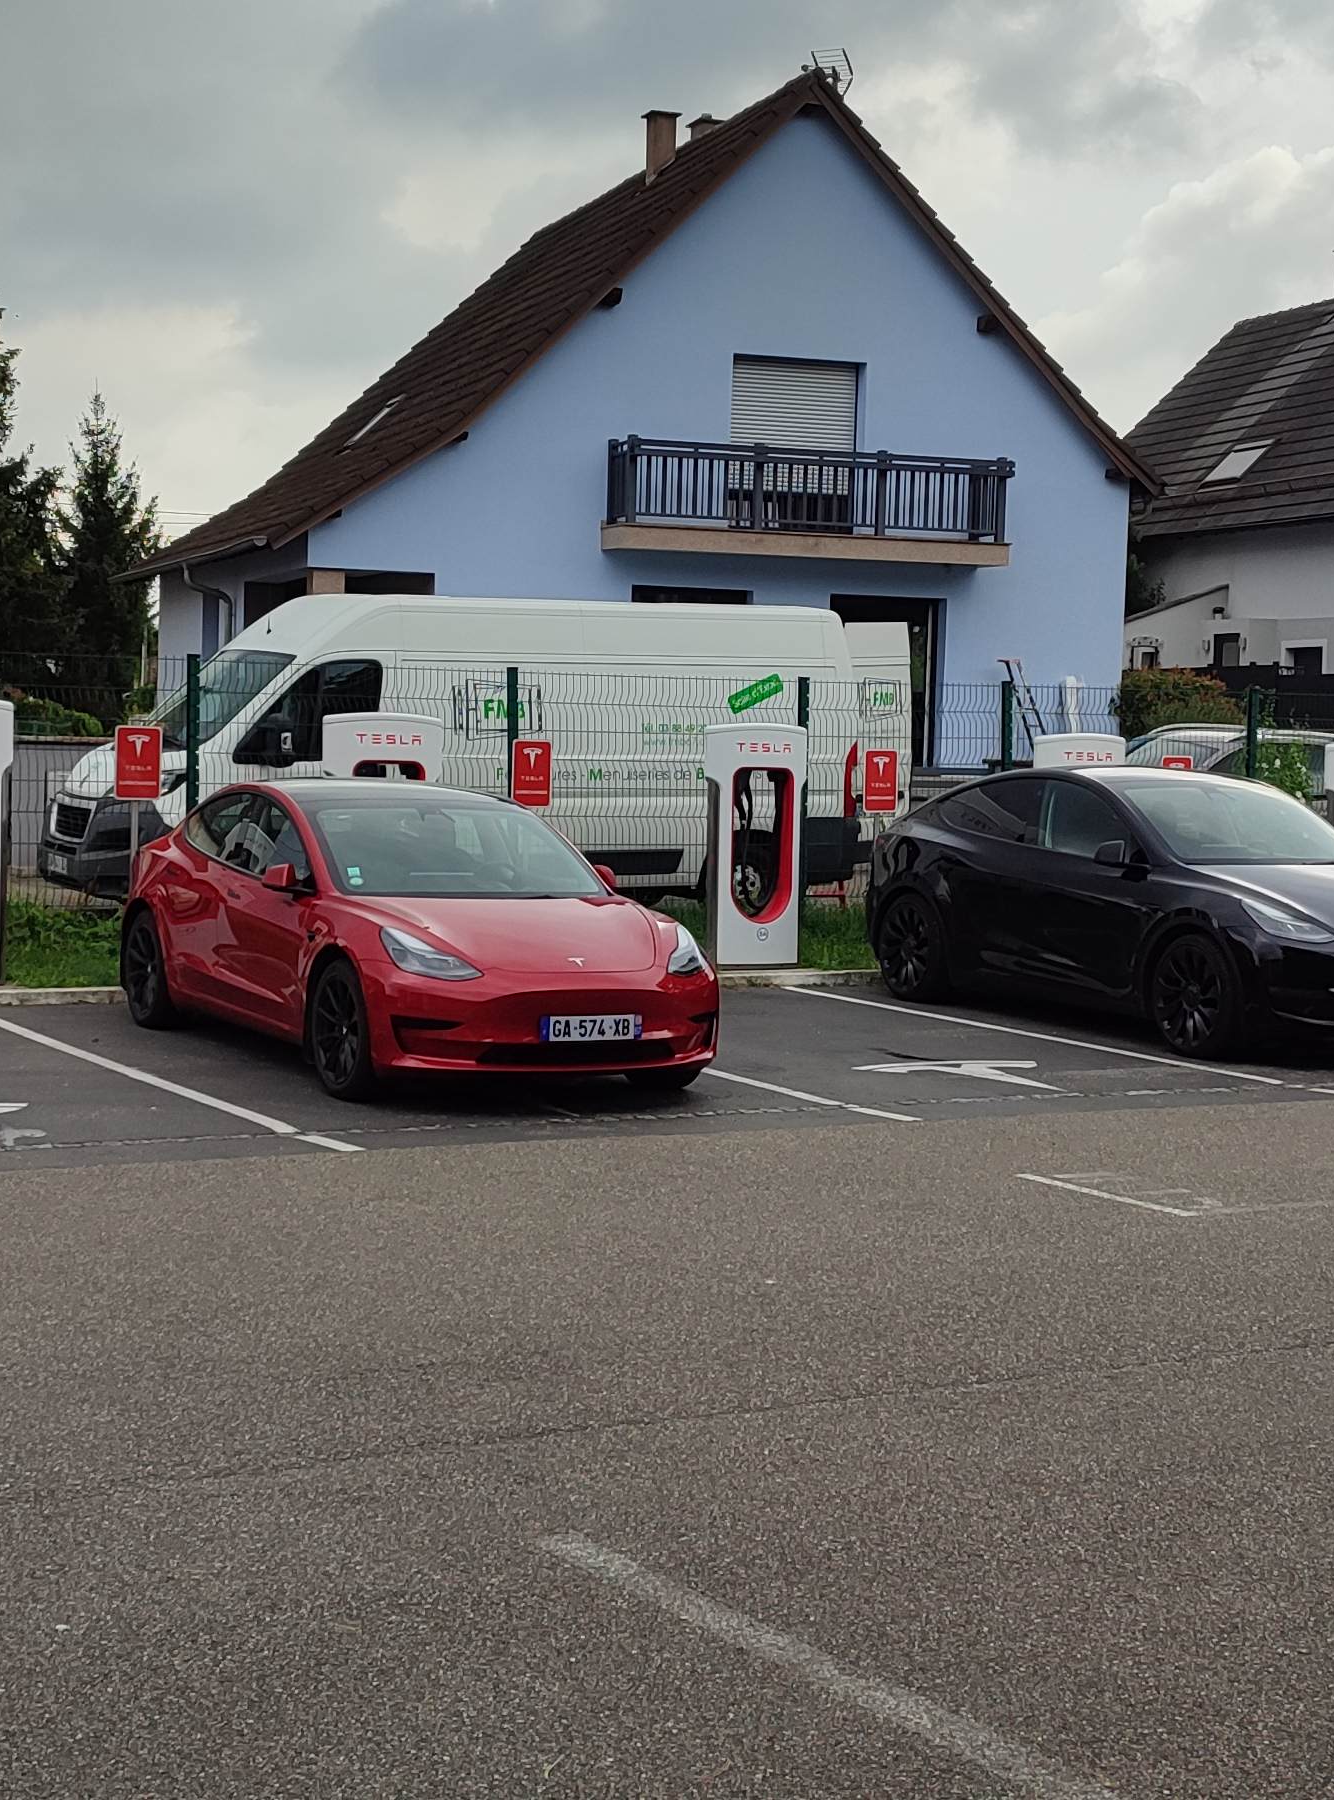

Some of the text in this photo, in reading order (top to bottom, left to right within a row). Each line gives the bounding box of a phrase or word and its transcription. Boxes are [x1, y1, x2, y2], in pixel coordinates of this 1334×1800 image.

[355, 733, 422, 746] TESLA
[736, 742, 791, 753] TESLA
[1064, 751, 1113, 761] TESLA
[589, 768, 671, 782] Menuiseries
[674, 768, 692, 781] de
[552, 1019, 630, 1038] GA-574-XB
